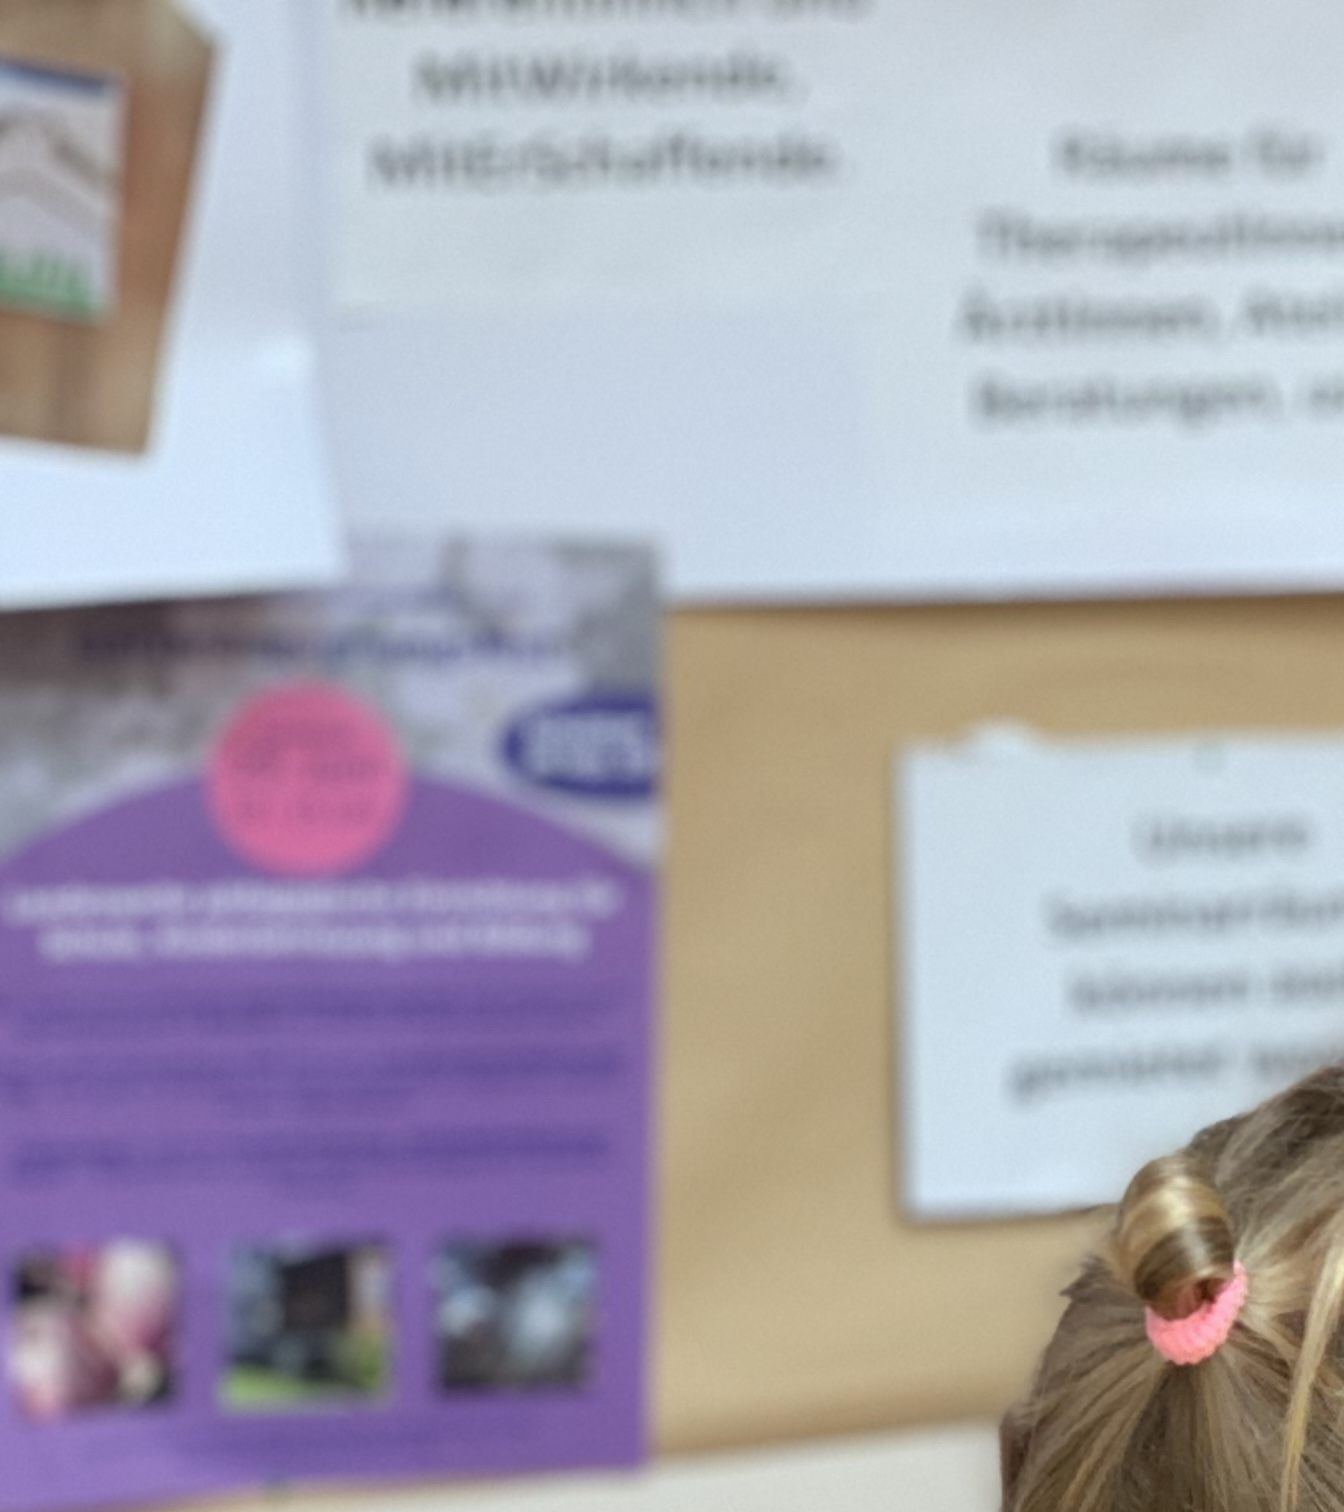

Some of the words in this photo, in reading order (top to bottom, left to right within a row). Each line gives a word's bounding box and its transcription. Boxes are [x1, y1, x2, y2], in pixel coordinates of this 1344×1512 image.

[1052, 128, 1242, 183] Räume
[1134, 814, 1317, 866] Unsere
[1066, 964, 1256, 1017] können
